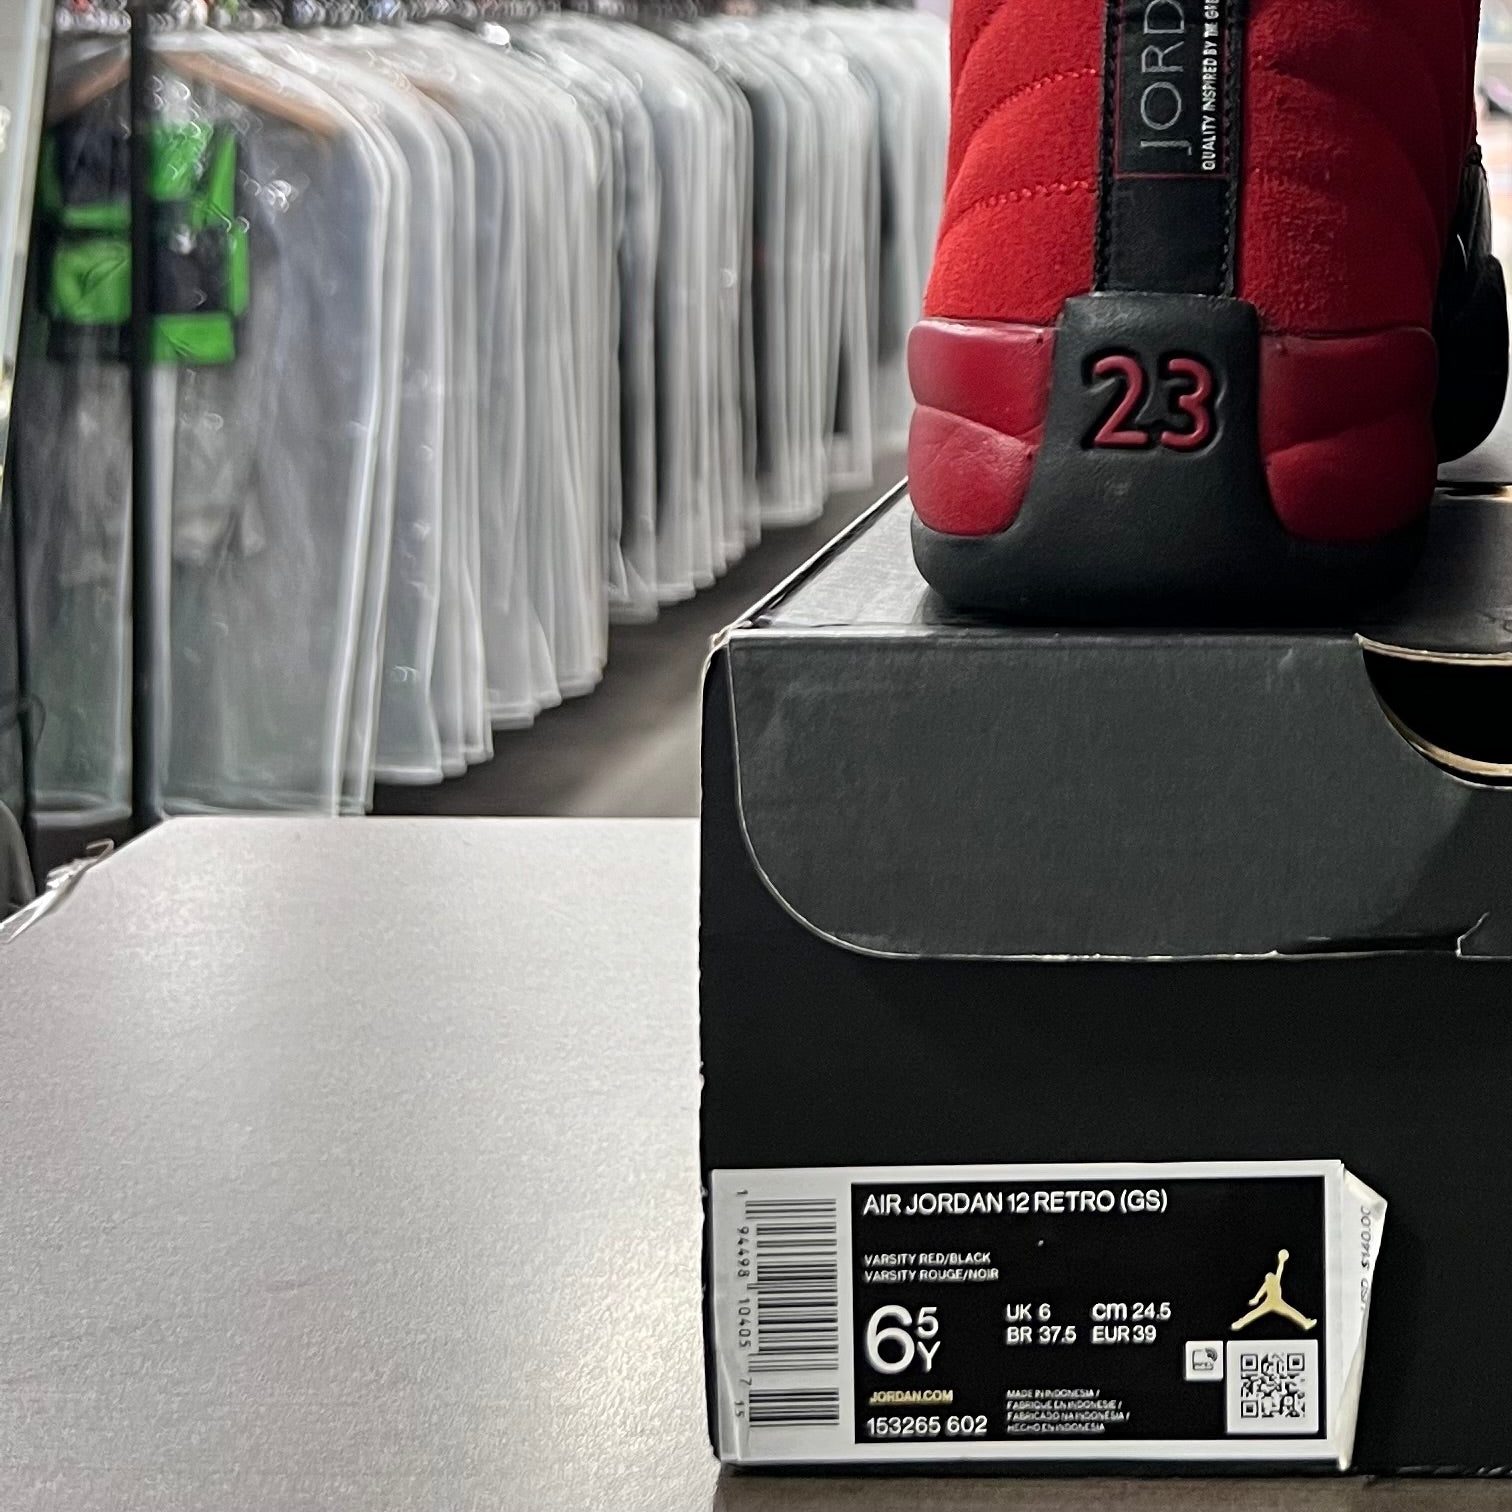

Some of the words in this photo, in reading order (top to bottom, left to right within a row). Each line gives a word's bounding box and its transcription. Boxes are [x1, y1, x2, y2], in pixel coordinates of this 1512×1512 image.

[1204, 41, 1218, 56] BY
[1203, 57, 1218, 112] INSPIRED
[1202, 115, 1216, 171] QUALITY
[1087, 349, 1217, 453] 23
[737, 1189, 749, 1197] 1
[862, 1193, 902, 1216] AIR
[904, 1191, 1003, 1215] JORDAN
[1006, 1191, 1030, 1214] 12
[1033, 1189, 1116, 1213] RETRO
[1119, 1188, 1169, 1214] (GS)
[737, 1226, 751, 1278] 94498
[864, 1253, 917, 1267] VARSITY
[918, 1251, 991, 1266] RED/BLACK
[864, 1269, 917, 1283] VARSITY
[919, 1267, 999, 1282] ROUGE/NOIR
[1006, 1303, 1033, 1322] UK
[1038, 1302, 1051, 1322] 6
[1131, 1301, 1172, 1321] 24.5
[739, 1298, 752, 1348] 10405
[916, 1306, 939, 1338] 5
[866, 1304, 915, 1374] 6
[1006, 1325, 1033, 1345] BR
[1038, 1325, 1077, 1345] 37.5
[1092, 1325, 1130, 1344] EUR
[1132, 1324, 1157, 1344] 39
[916, 1340, 941, 1372] Y
[739, 1377, 752, 1386] 7
[869, 1389, 954, 1404] JORDAN.COM
[1006, 1389, 1033, 1398] MADE
[1034, 1389, 1044, 1398] IN
[1045, 1389, 1095, 1398] INDONESIA
[734, 1400, 746, 1418] 15
[1006, 1400, 1053, 1410] FABRIQUE
[1053, 1400, 1067, 1409] EN
[866, 1415, 942, 1437] 153265
[946, 1414, 988, 1435] 602
[1006, 1411, 1060, 1421] FABRICADO
[1006, 1423, 1041, 1432] HECHO
[1041, 1423, 1055, 1432] EN
[1055, 1423, 1106, 1432] INDONESIA
